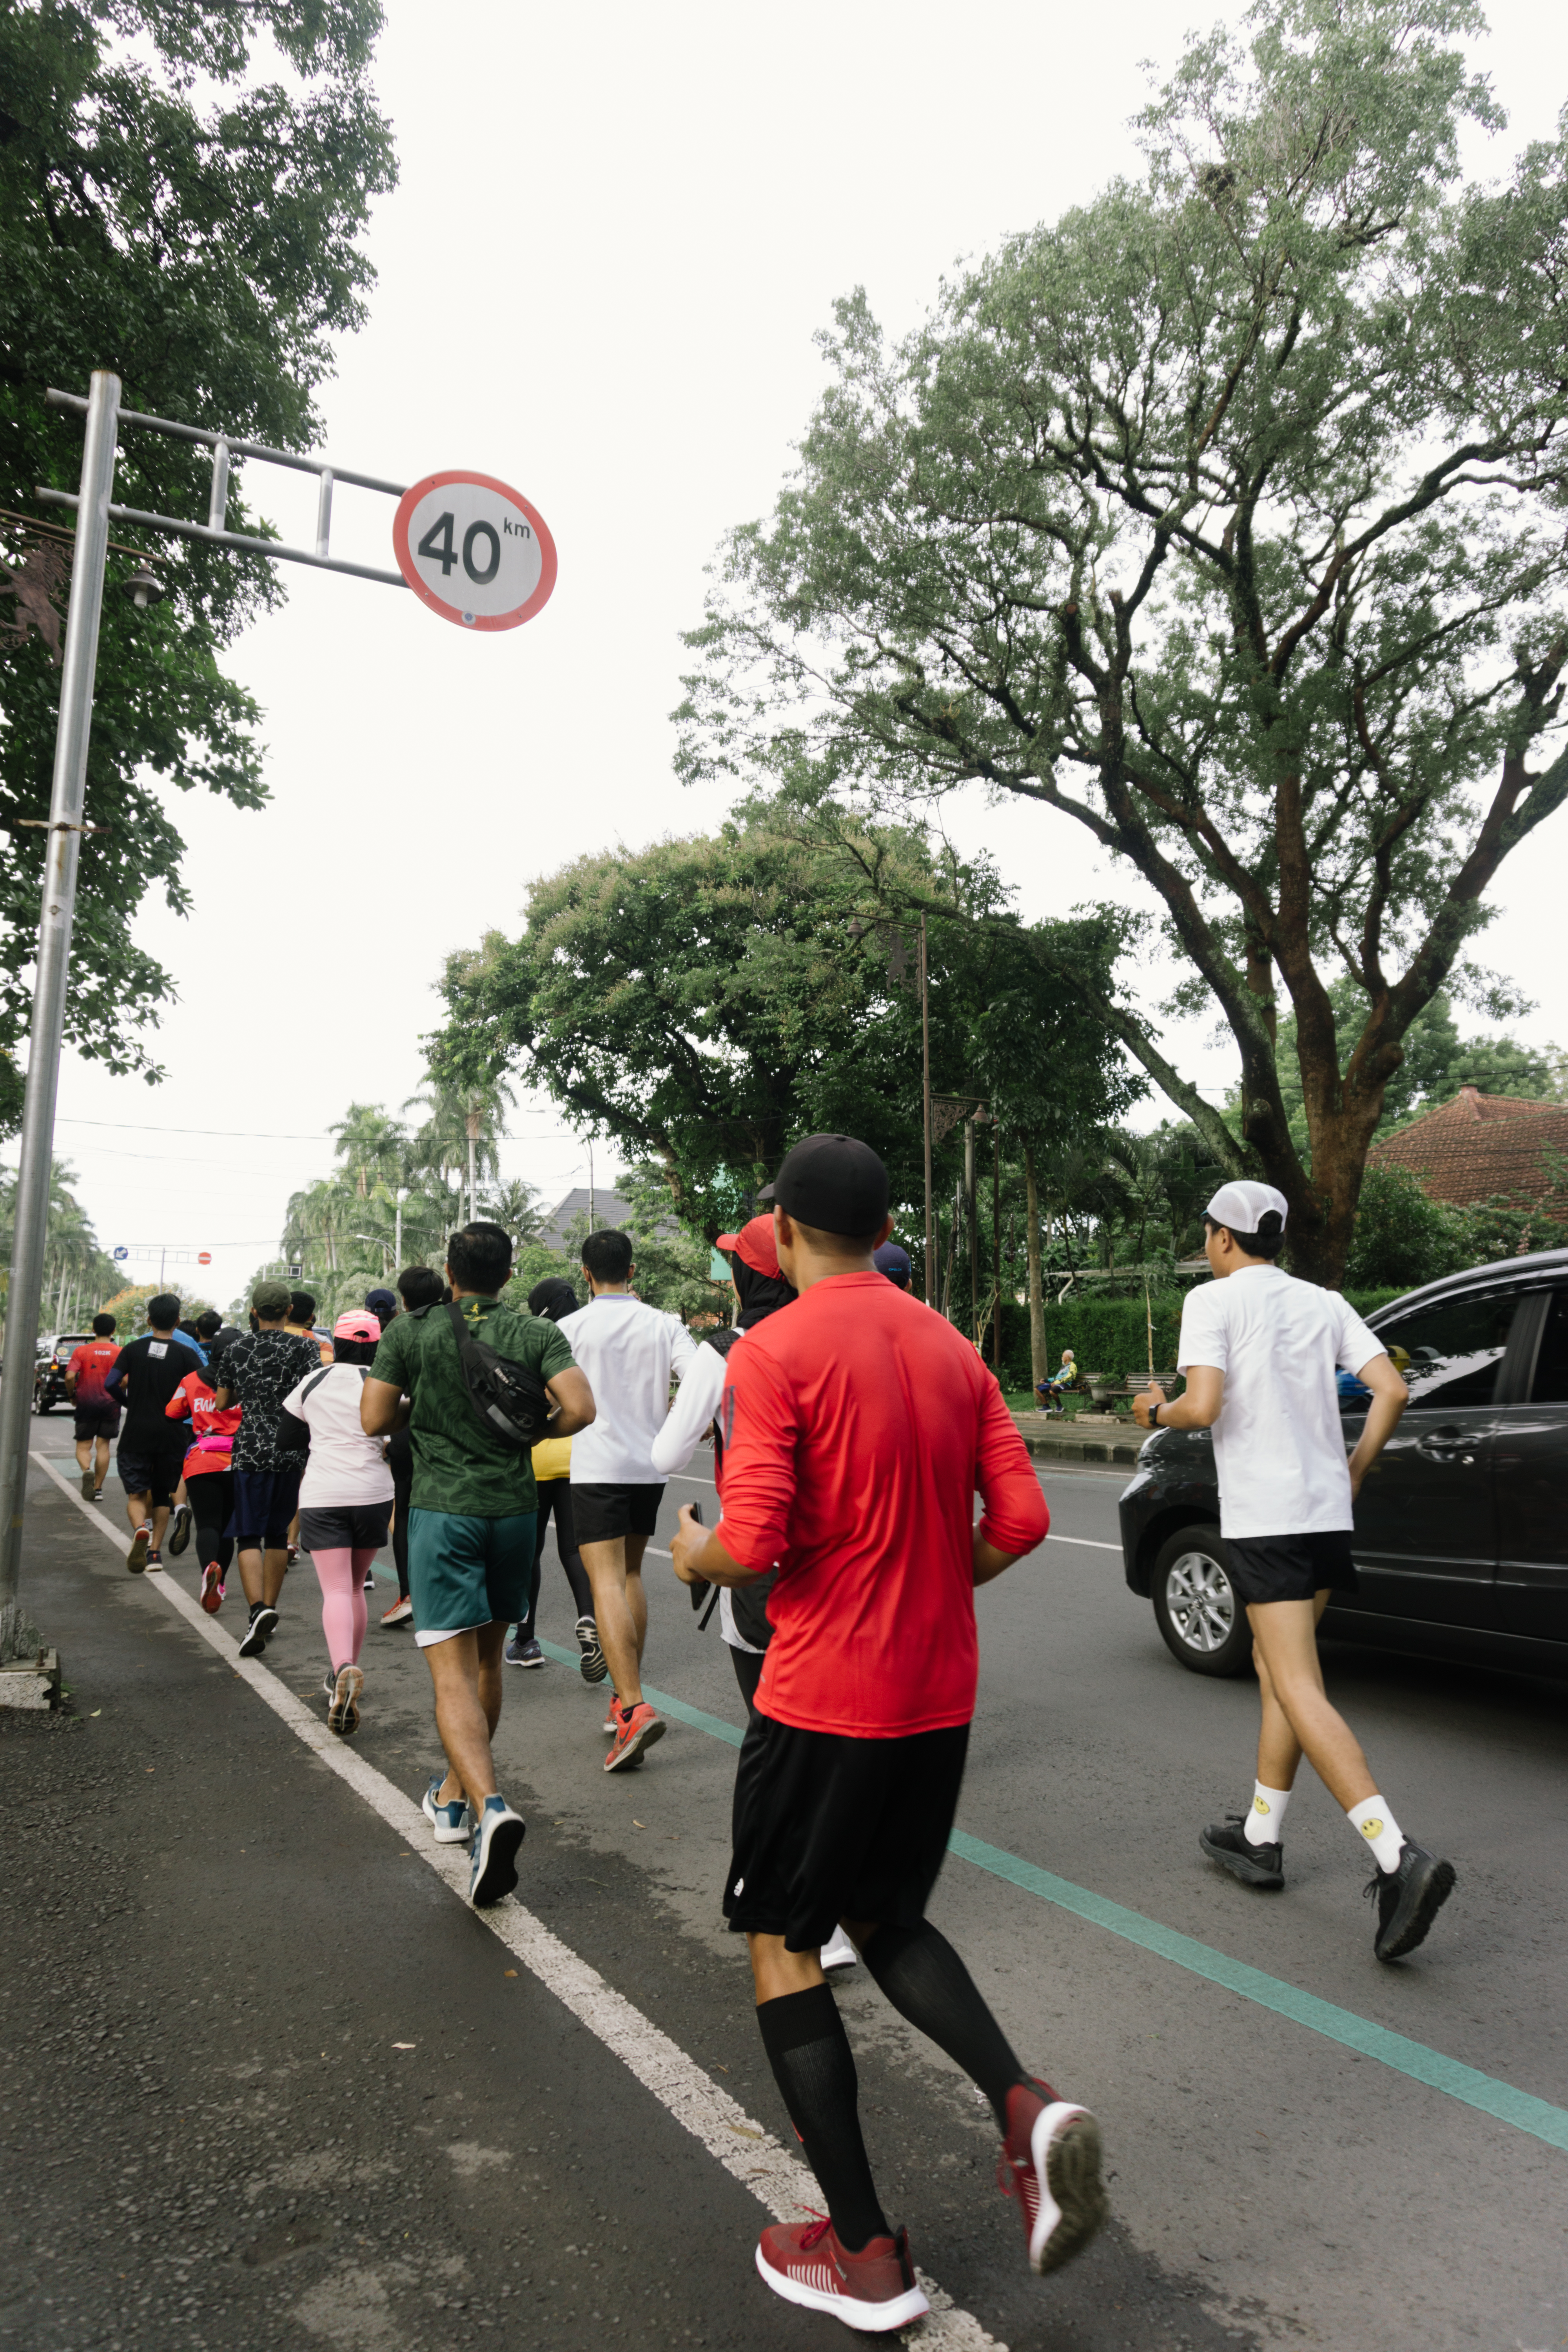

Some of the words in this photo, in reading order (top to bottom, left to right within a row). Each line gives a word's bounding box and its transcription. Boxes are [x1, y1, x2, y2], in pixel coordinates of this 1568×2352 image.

[418, 511, 501, 585] 40
[504, 517, 530, 539] km
[1398, 1852, 1418, 1884] HOKA
